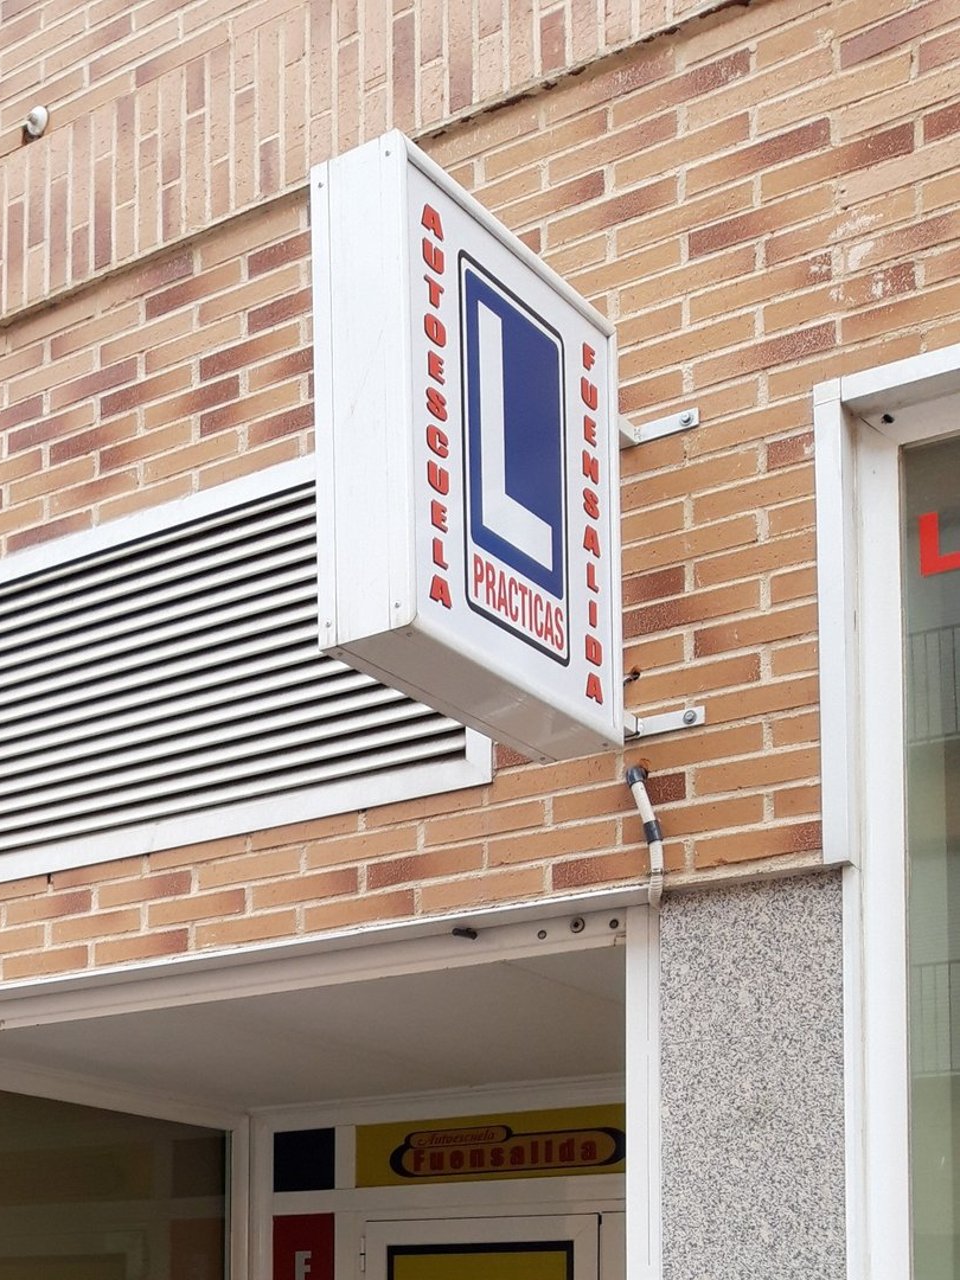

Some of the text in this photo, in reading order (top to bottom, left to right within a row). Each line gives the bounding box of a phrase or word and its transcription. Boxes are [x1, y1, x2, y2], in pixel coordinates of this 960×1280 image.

[421, 202, 453, 609] AUTOESCUELA
[477, 299, 553, 572] L
[473, 559, 565, 652] PRACTICAS
[581, 342, 603, 706] FUENSALIDA
[413, 1138, 597, 1172] Fuensalida
[418, 1131, 495, 1146] Autoescuela
